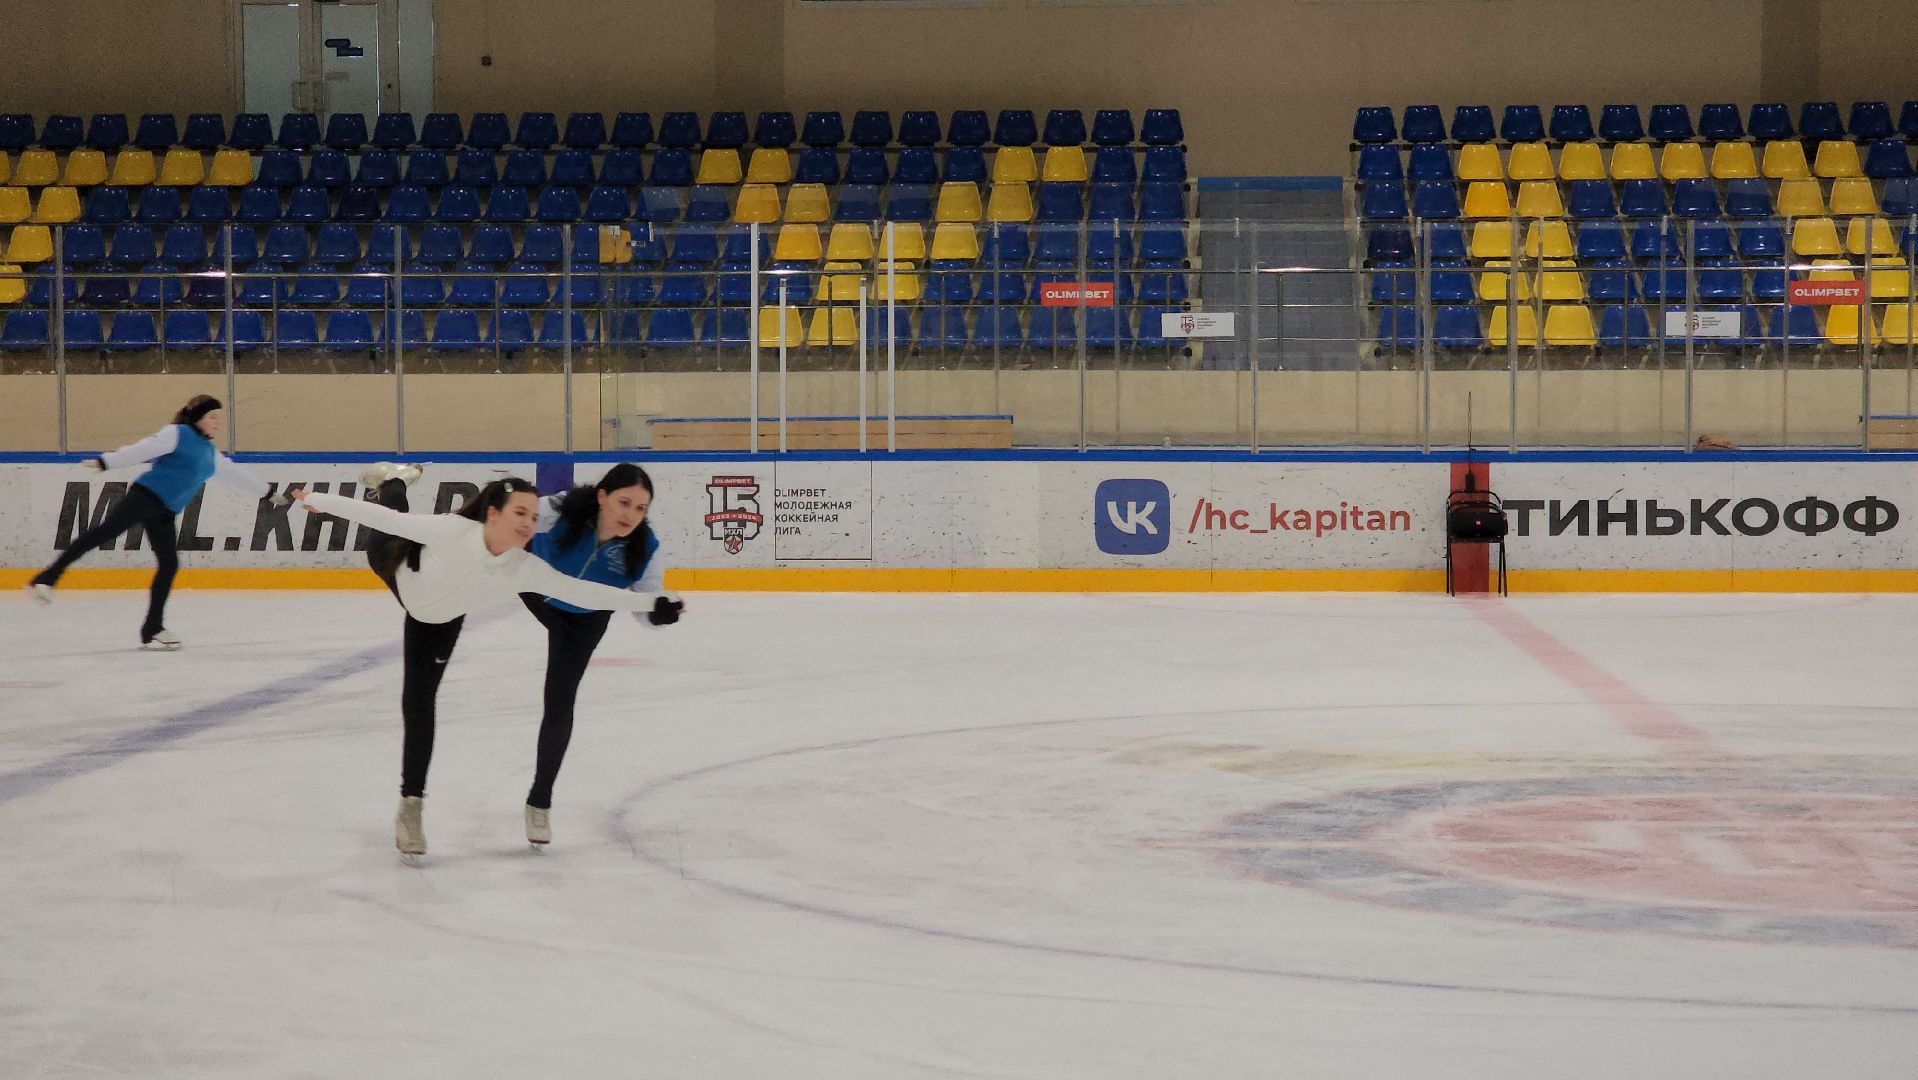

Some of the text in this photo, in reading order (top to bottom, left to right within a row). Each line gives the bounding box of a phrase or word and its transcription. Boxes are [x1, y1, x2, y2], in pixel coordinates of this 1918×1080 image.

[1045, 290, 1110, 299] OLIMBET
[1794, 288, 1860, 297] OLIMPBET
[775, 488, 826, 497] OLIMPBET
[775, 501, 852, 511] МОЛОДЕЖНАЯ
[774, 511, 839, 523] ХОККЕЙНАЯ
[1188, 498, 1411, 538] /hc_kapitan
[1501, 496, 1900, 536] ТИНЬКОФФ
[775, 526, 802, 535] ЛИГА
